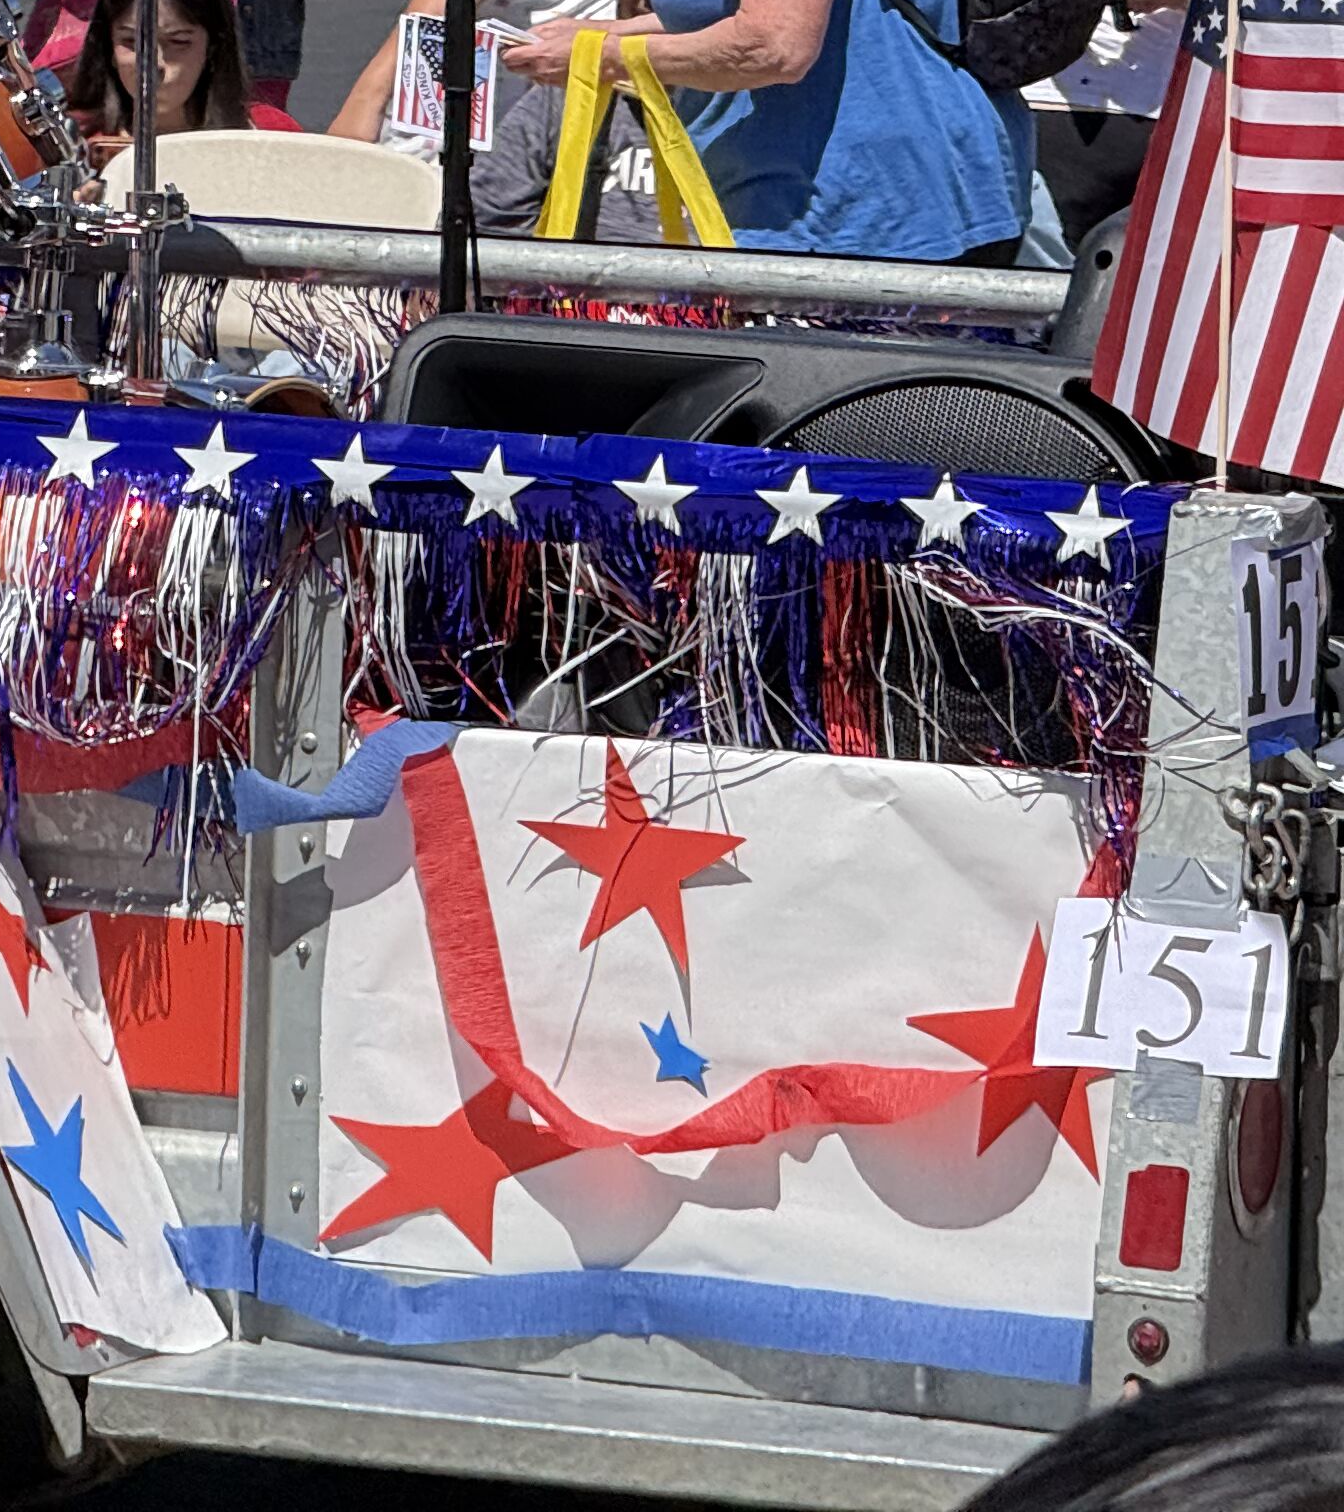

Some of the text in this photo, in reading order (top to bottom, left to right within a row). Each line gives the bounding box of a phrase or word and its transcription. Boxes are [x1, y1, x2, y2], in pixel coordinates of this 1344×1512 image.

[415, 63, 432, 102] KINGS
[1242, 553, 1320, 718] 15
[1067, 925, 1275, 1061] 151
